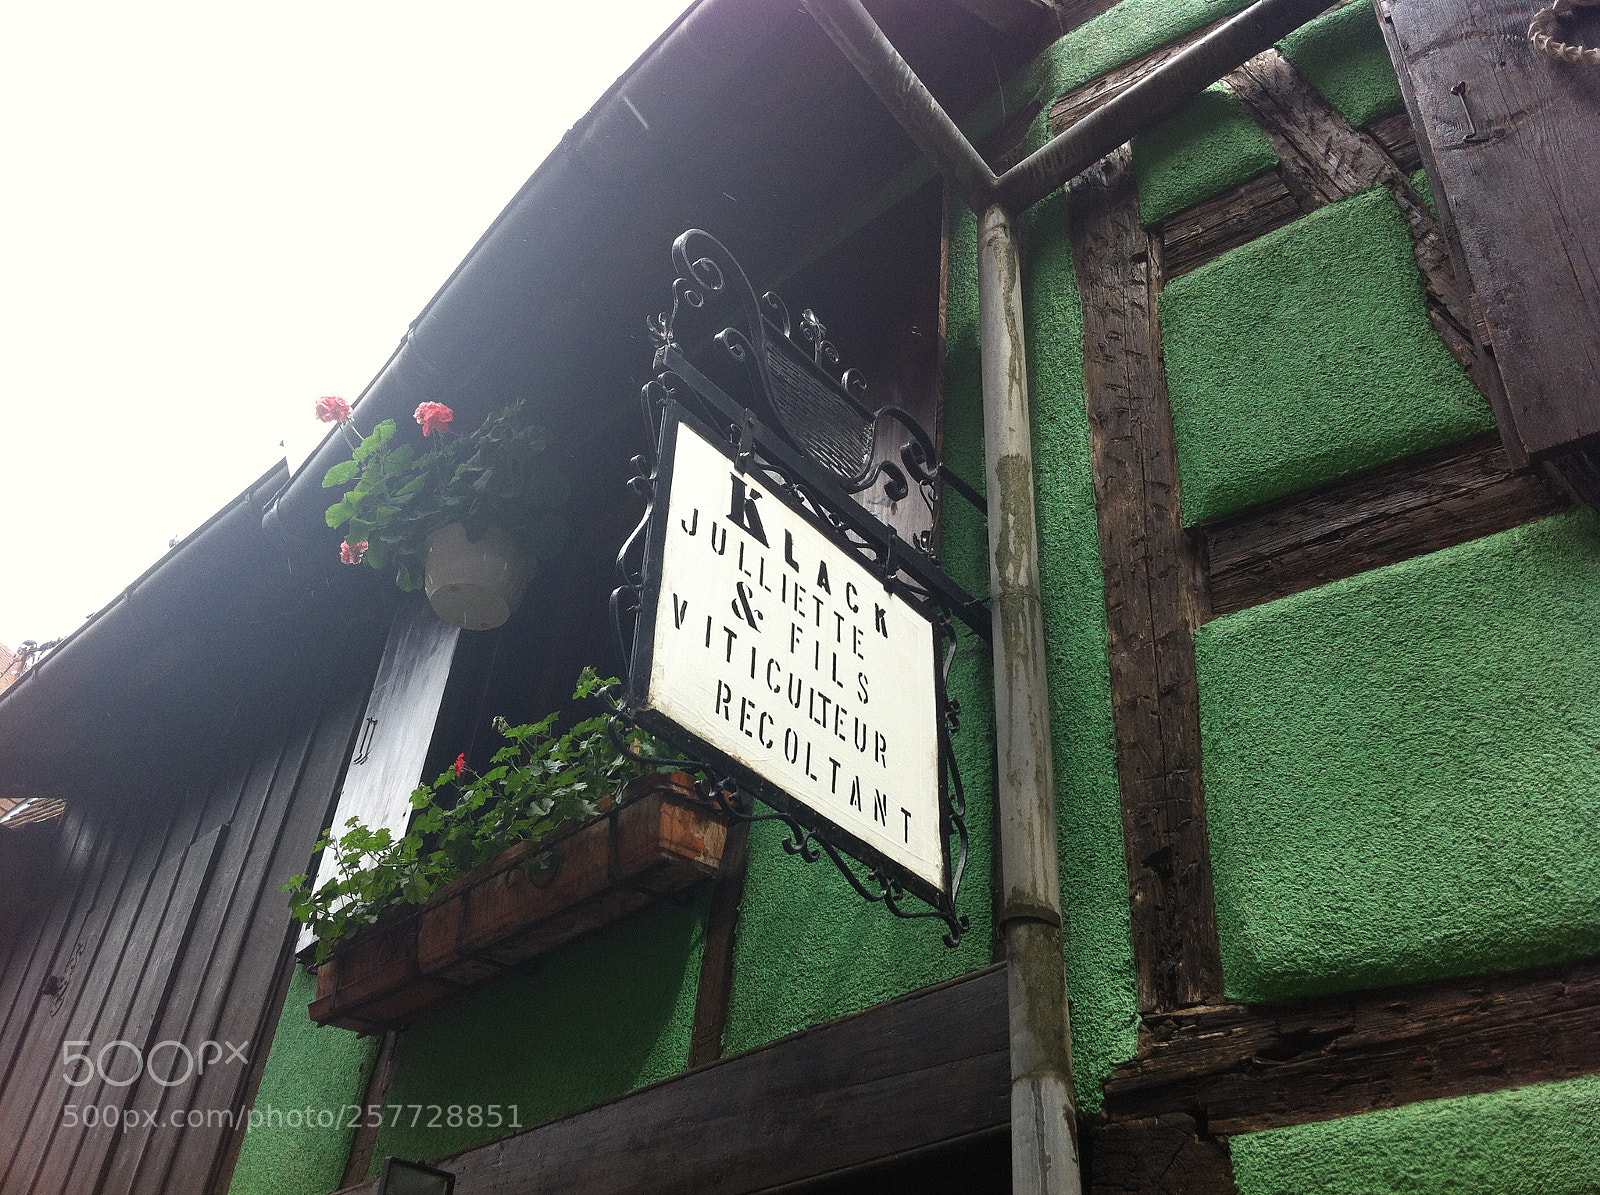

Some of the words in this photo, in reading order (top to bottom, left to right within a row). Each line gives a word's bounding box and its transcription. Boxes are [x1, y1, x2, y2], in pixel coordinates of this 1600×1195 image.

[681, 508, 865, 661] JULLIETTE
[726, 472, 889, 639] KLACK
[673, 593, 887, 769] VITICULTEUR
[731, 581, 764, 633] &
[790, 622, 869, 705] FILS
[715, 679, 912, 844] RECOLTANT
